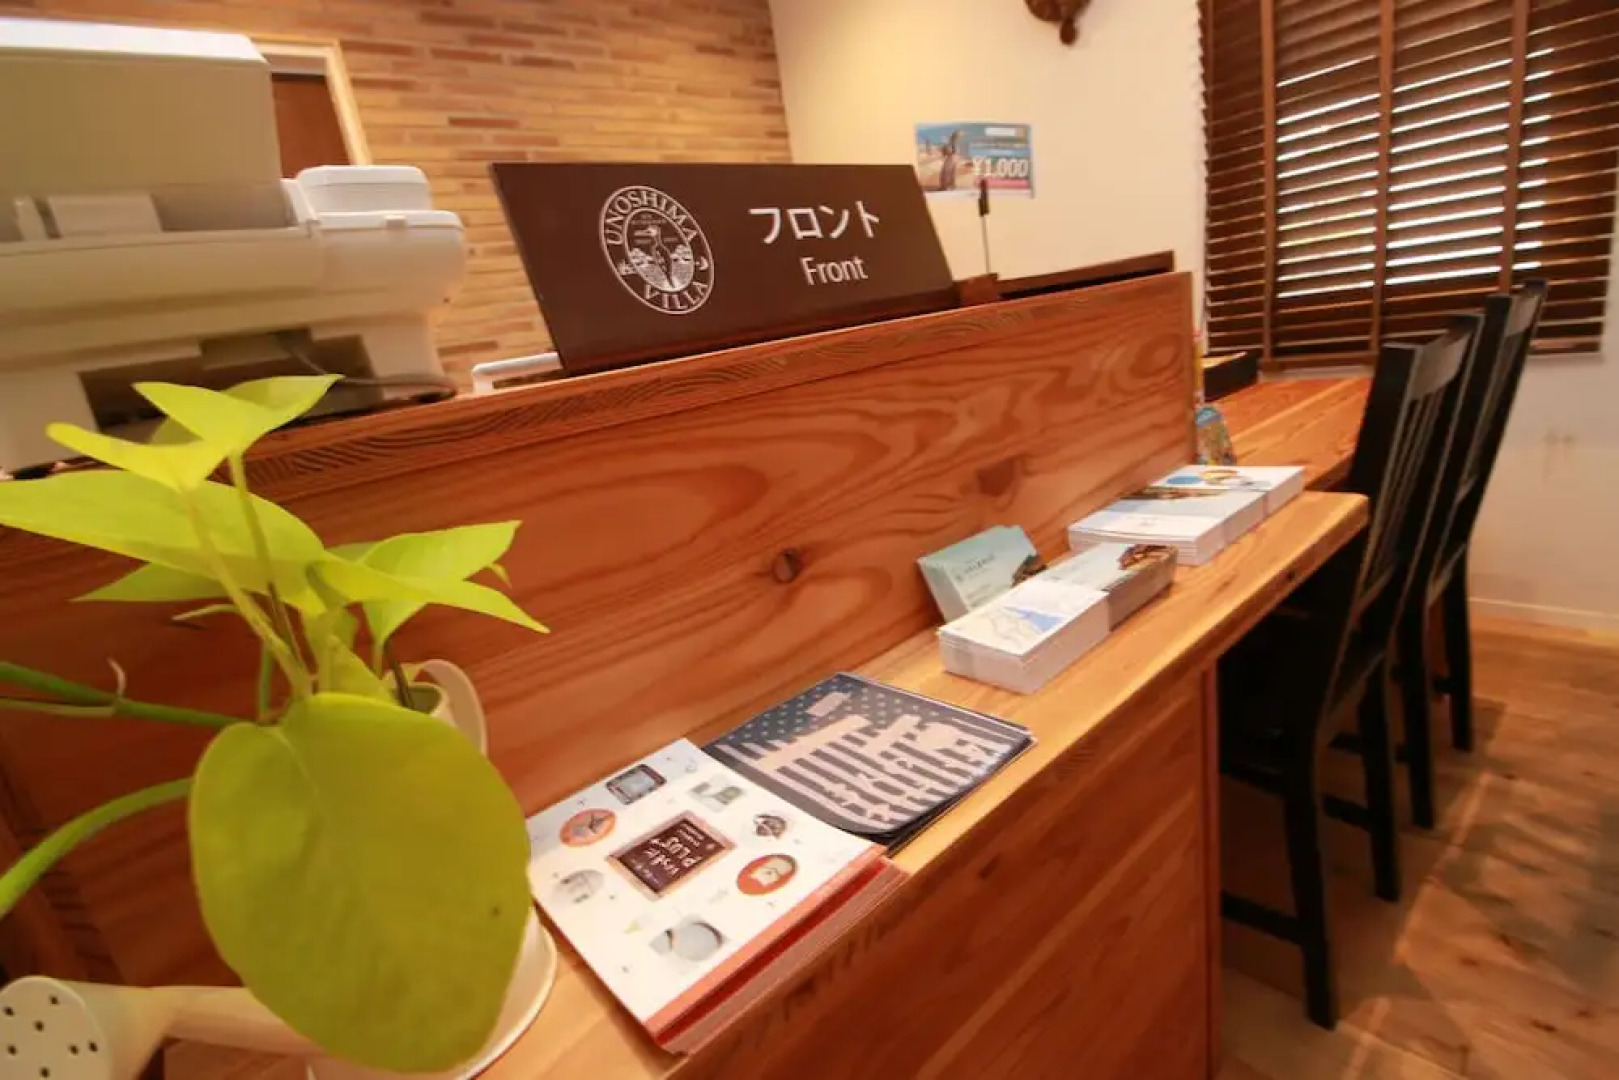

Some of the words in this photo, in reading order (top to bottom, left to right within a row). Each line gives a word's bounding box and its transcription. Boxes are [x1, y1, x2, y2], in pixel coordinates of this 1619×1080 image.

[604, 190, 698, 245] UNOSHIMA
[748, 200, 880, 244] フロント
[800, 255, 868, 285] Front
[644, 281, 708, 309] VILLA
